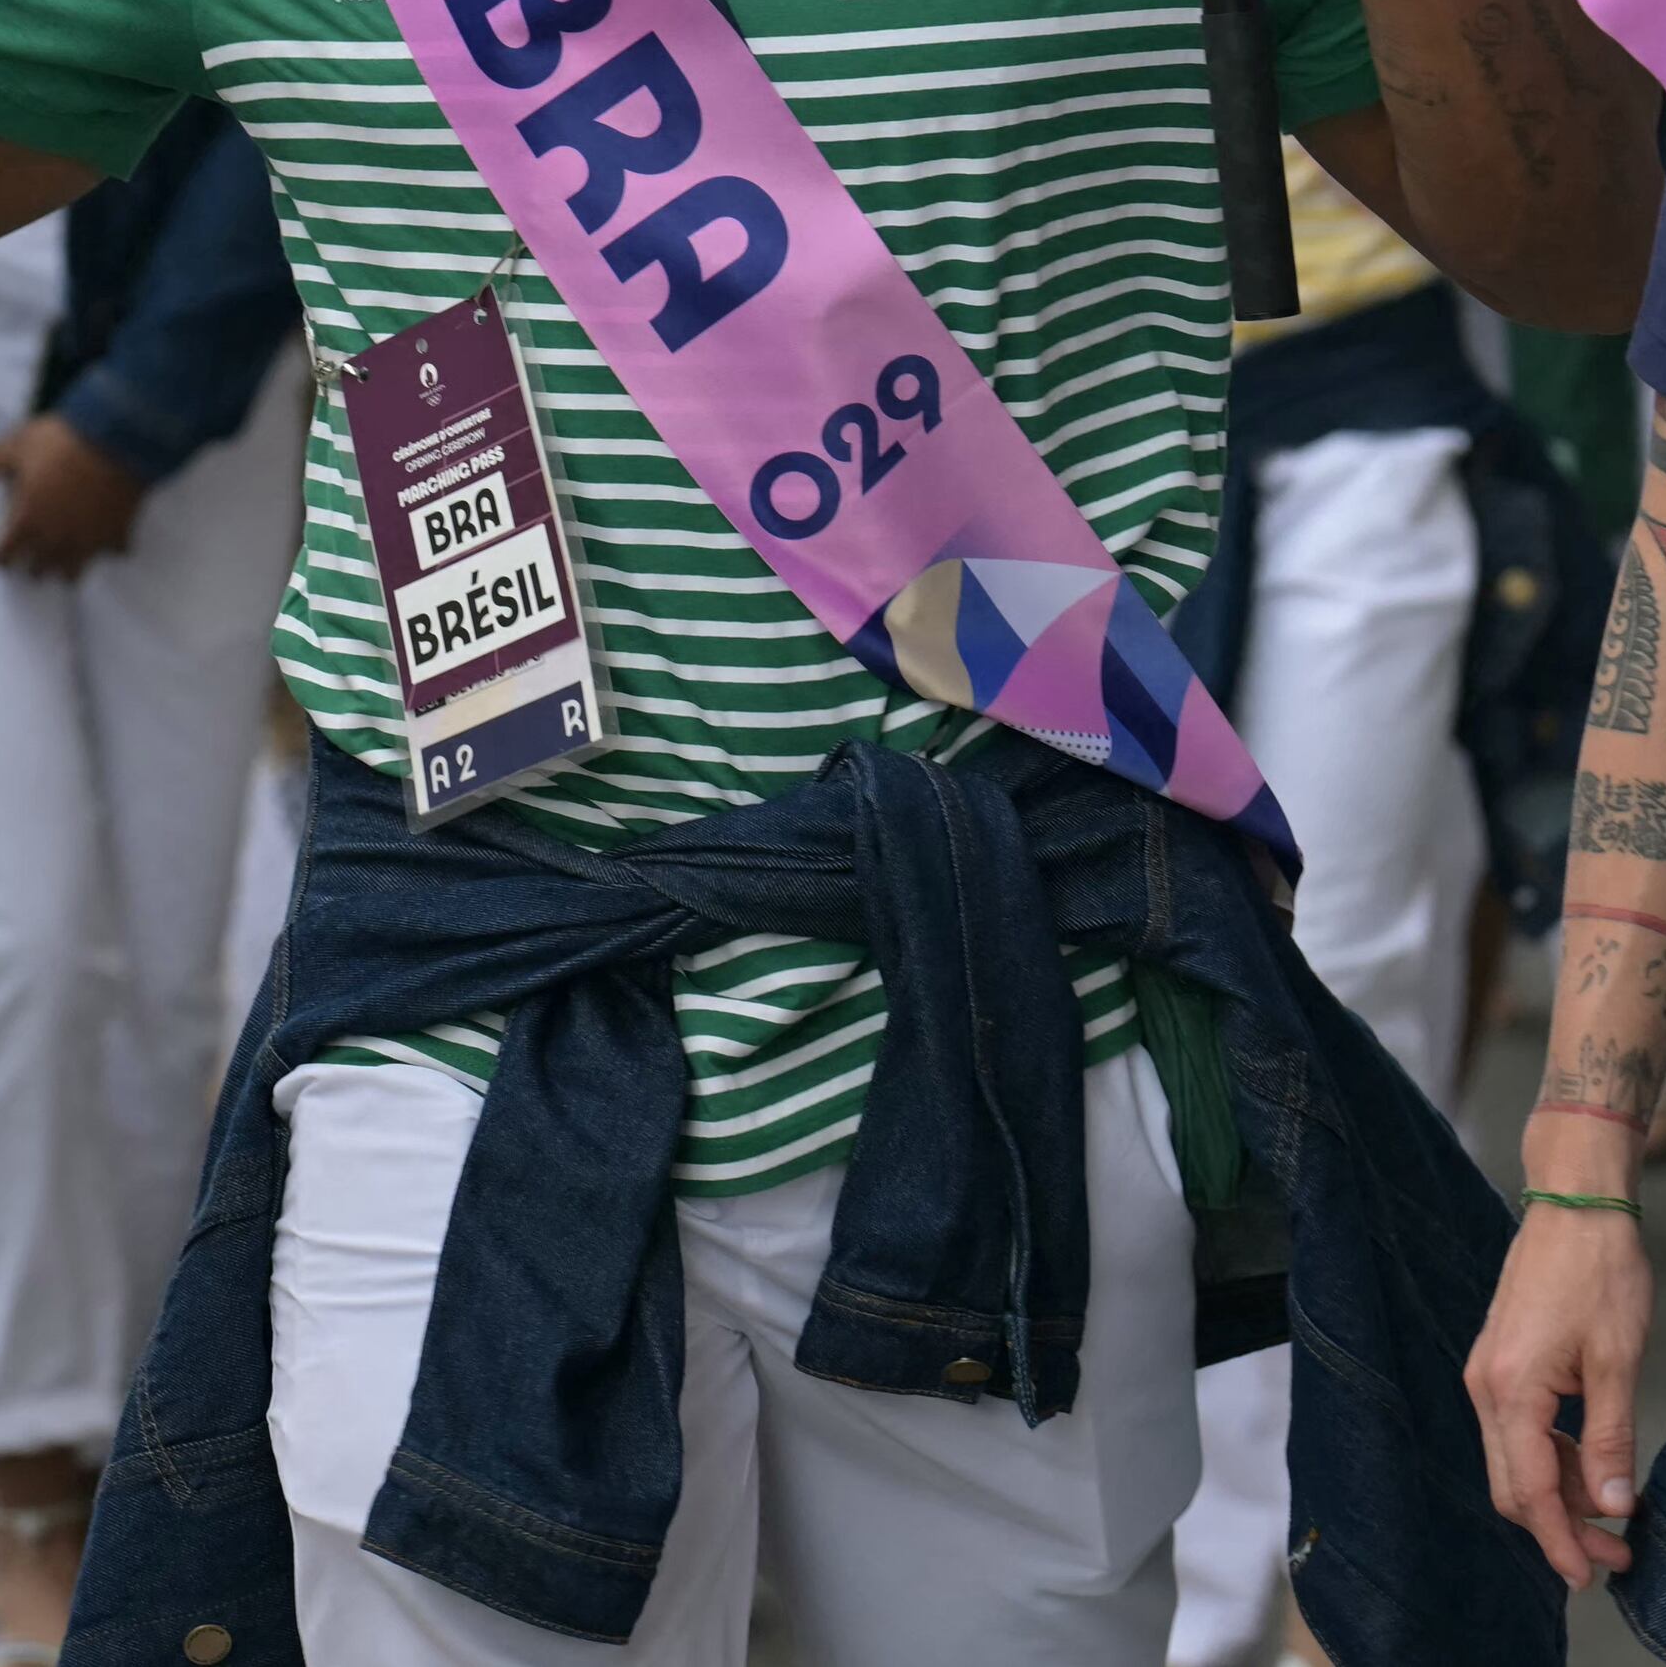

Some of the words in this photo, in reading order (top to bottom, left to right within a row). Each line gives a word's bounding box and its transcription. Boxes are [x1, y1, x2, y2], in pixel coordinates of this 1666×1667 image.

[396, 463, 473, 508] MARCHING
[469, 445, 506, 474] PASS
[404, 448, 443, 473] OPENING
[424, 488, 502, 556] BRA
[406, 562, 556, 666] BRÉSIL
[560, 699, 586, 737] R
